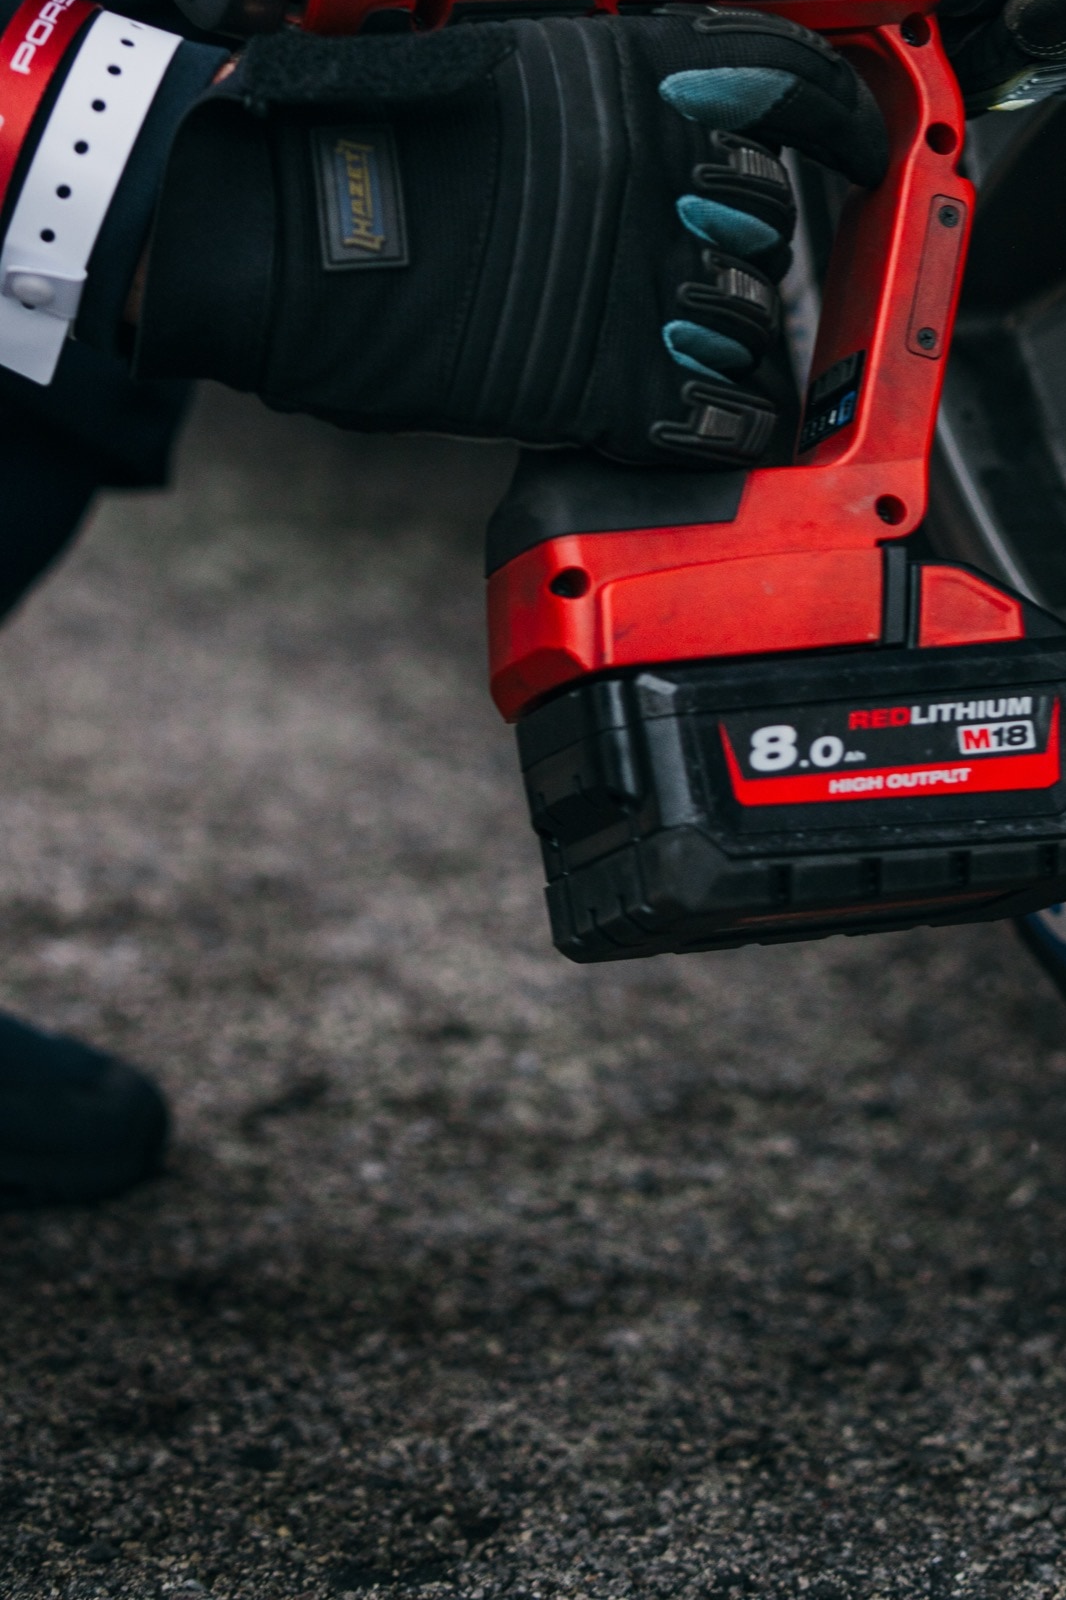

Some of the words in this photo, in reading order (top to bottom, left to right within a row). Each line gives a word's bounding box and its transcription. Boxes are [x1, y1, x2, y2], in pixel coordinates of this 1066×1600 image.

[848, 696, 1033, 731] REDLITHIUM
[962, 724, 1030, 750] M18
[828, 775, 884, 795] HIGH
[886, 767, 971, 791] OUTPUT
